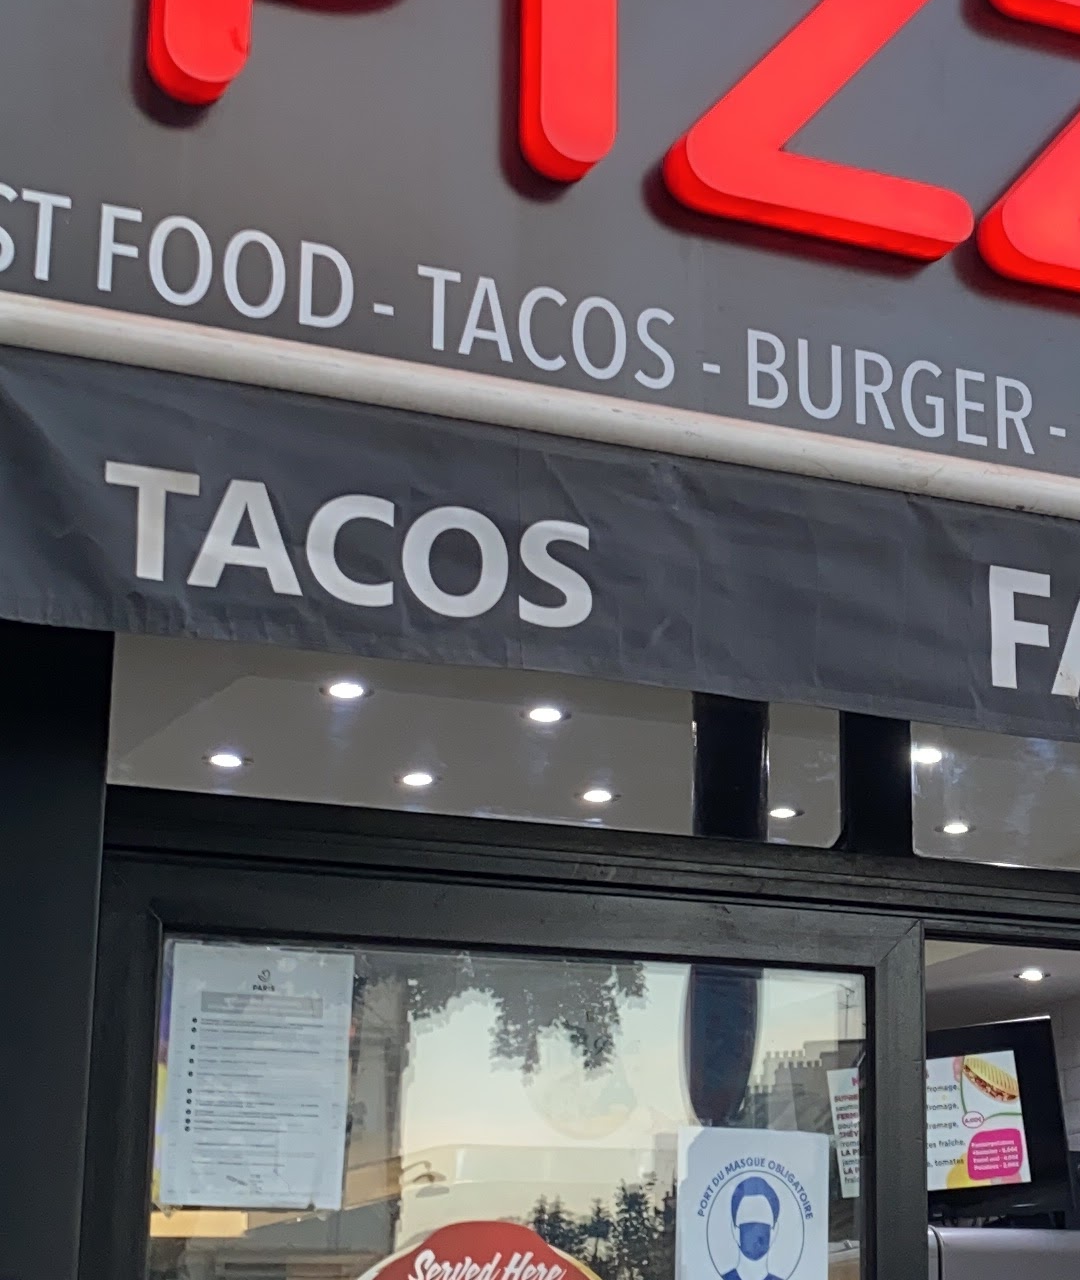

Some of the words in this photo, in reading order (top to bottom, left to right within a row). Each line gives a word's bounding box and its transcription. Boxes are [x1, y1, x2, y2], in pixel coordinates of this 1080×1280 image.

[97, 202, 355, 329] FOOD
[417, 263, 675, 390] TACOS
[747, 328, 1036, 455] BURGER
[104, 460, 594, 629] TACOS
[697, 1186, 714, 1217] PORT
[712, 1170, 725, 1186] DU
[724, 1157, 766, 1175] MASQUE
[767, 1160, 814, 1220] OBLIGATOIRE
